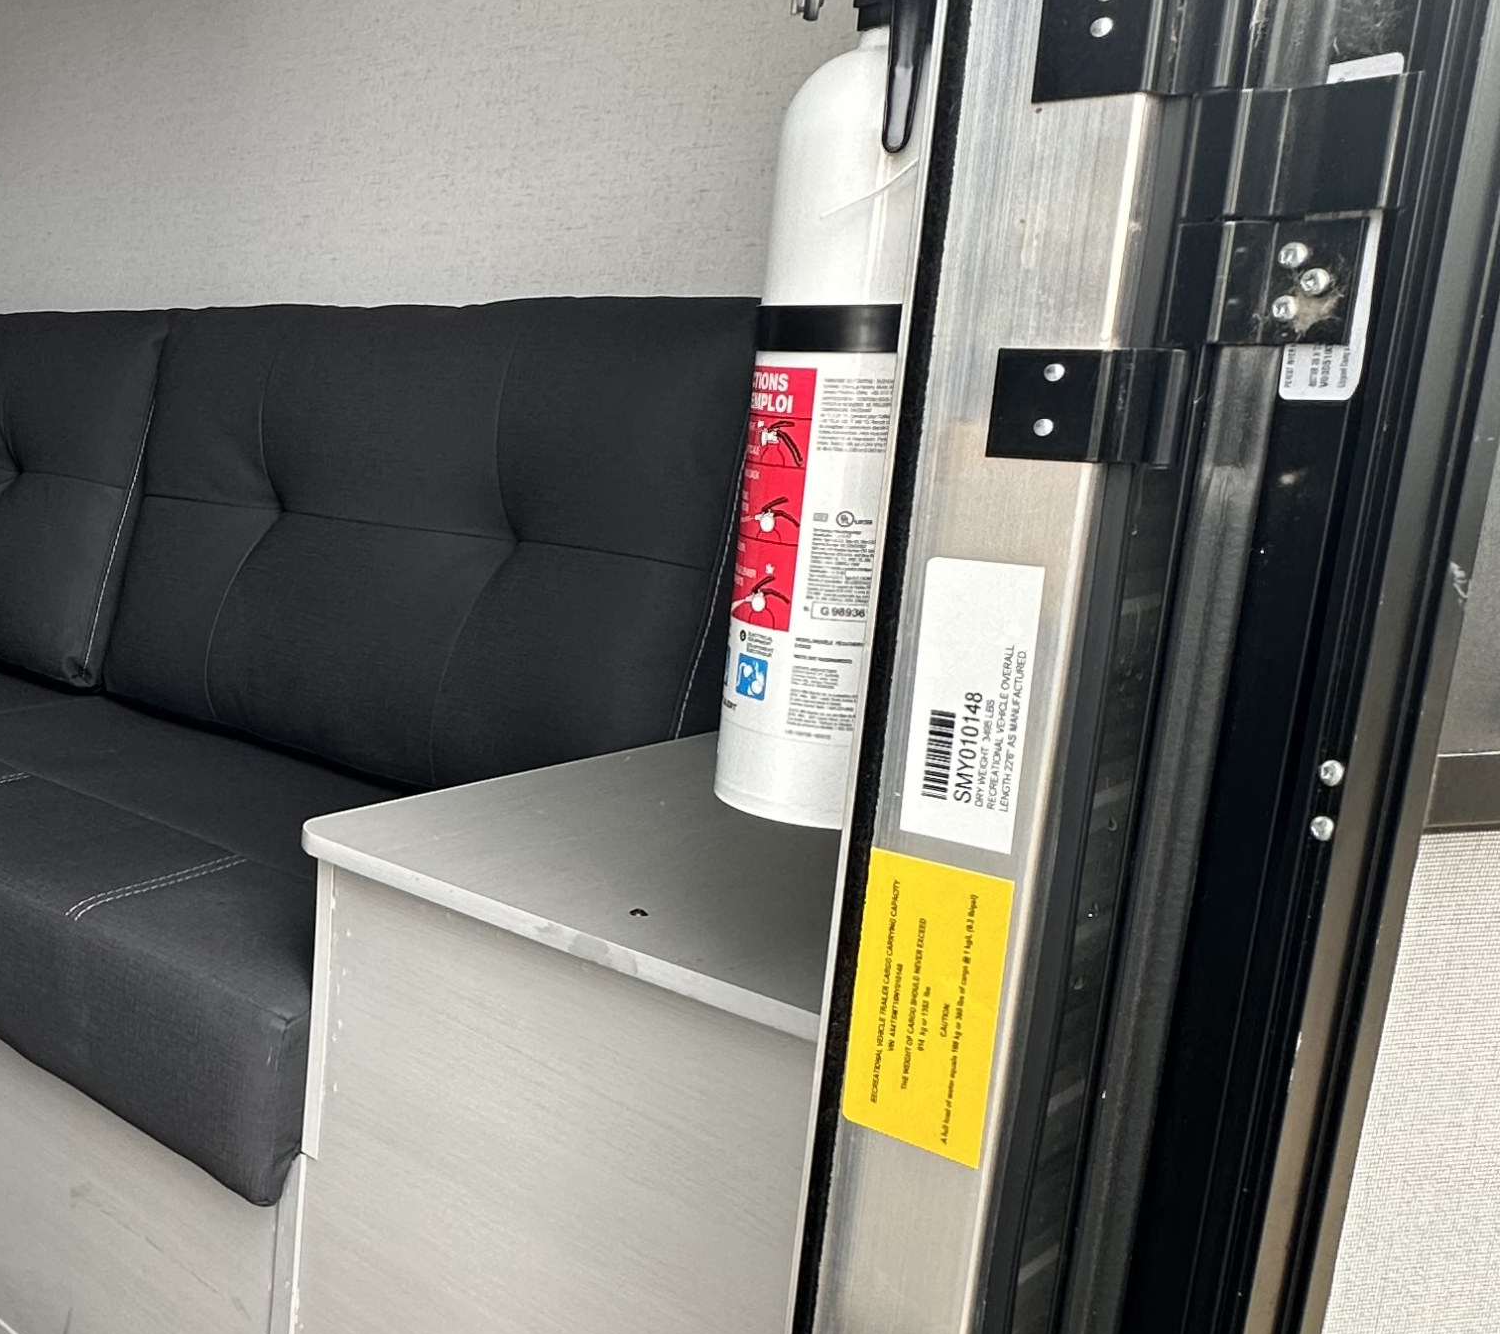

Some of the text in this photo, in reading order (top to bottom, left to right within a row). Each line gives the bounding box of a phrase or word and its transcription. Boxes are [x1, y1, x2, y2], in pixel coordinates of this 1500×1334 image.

[985, 699, 995, 718] LBS
[986, 645, 1014, 810] RECREATIONAL VEHICLE OVERALL
[953, 692, 982, 803] SMY010148
[977, 747, 989, 784] WEIGHT
[999, 774, 1012, 812] LENGTH
[1007, 734, 1017, 748] AS
[974, 787, 984, 807] DRY
[916, 918, 927, 948] EXCEED
[914, 950, 923, 974] NEVER
[870, 879, 900, 1103] RECREATIONAL VEHICLE TRAILER CARGO CARRYING CAPACITY
[910, 976, 920, 1006] SHOULD
[907, 1007, 916, 1034] CARGO
[903, 1046, 911, 1074] WEIGHT
[901, 1076, 909, 1089] THE
